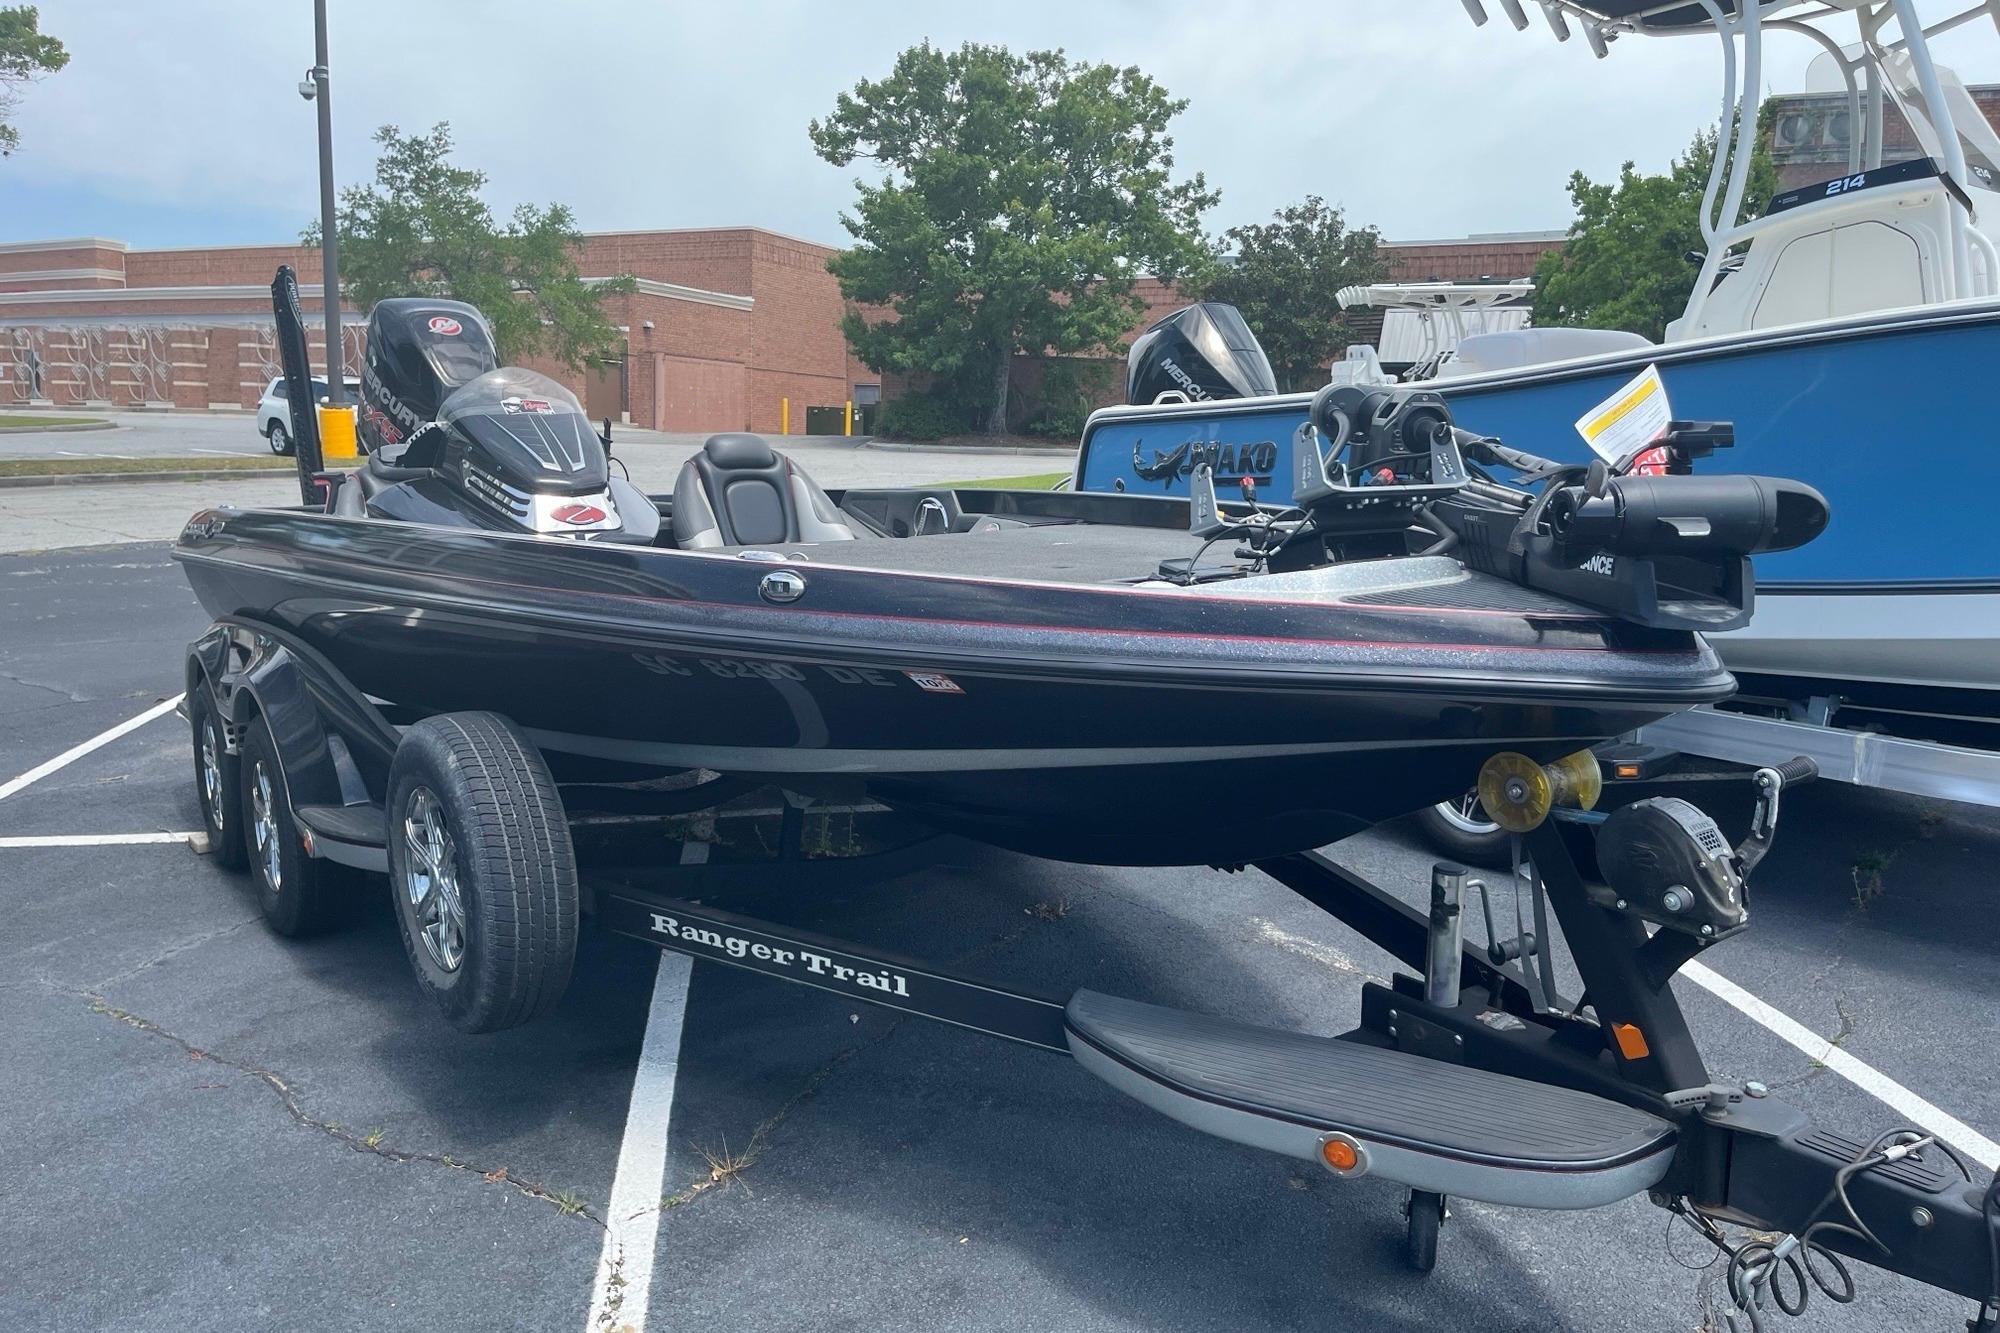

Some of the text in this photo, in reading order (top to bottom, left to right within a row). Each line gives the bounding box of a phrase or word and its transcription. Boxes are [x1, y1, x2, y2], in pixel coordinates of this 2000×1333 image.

[1973, 166, 1992, 180] 214
[1825, 174, 1865, 196] 214
[1579, 555, 1614, 575] ANCE
[631, 653, 693, 676] SC
[818, 665, 898, 686] DE
[650, 913, 910, 997] Ranger Trail
